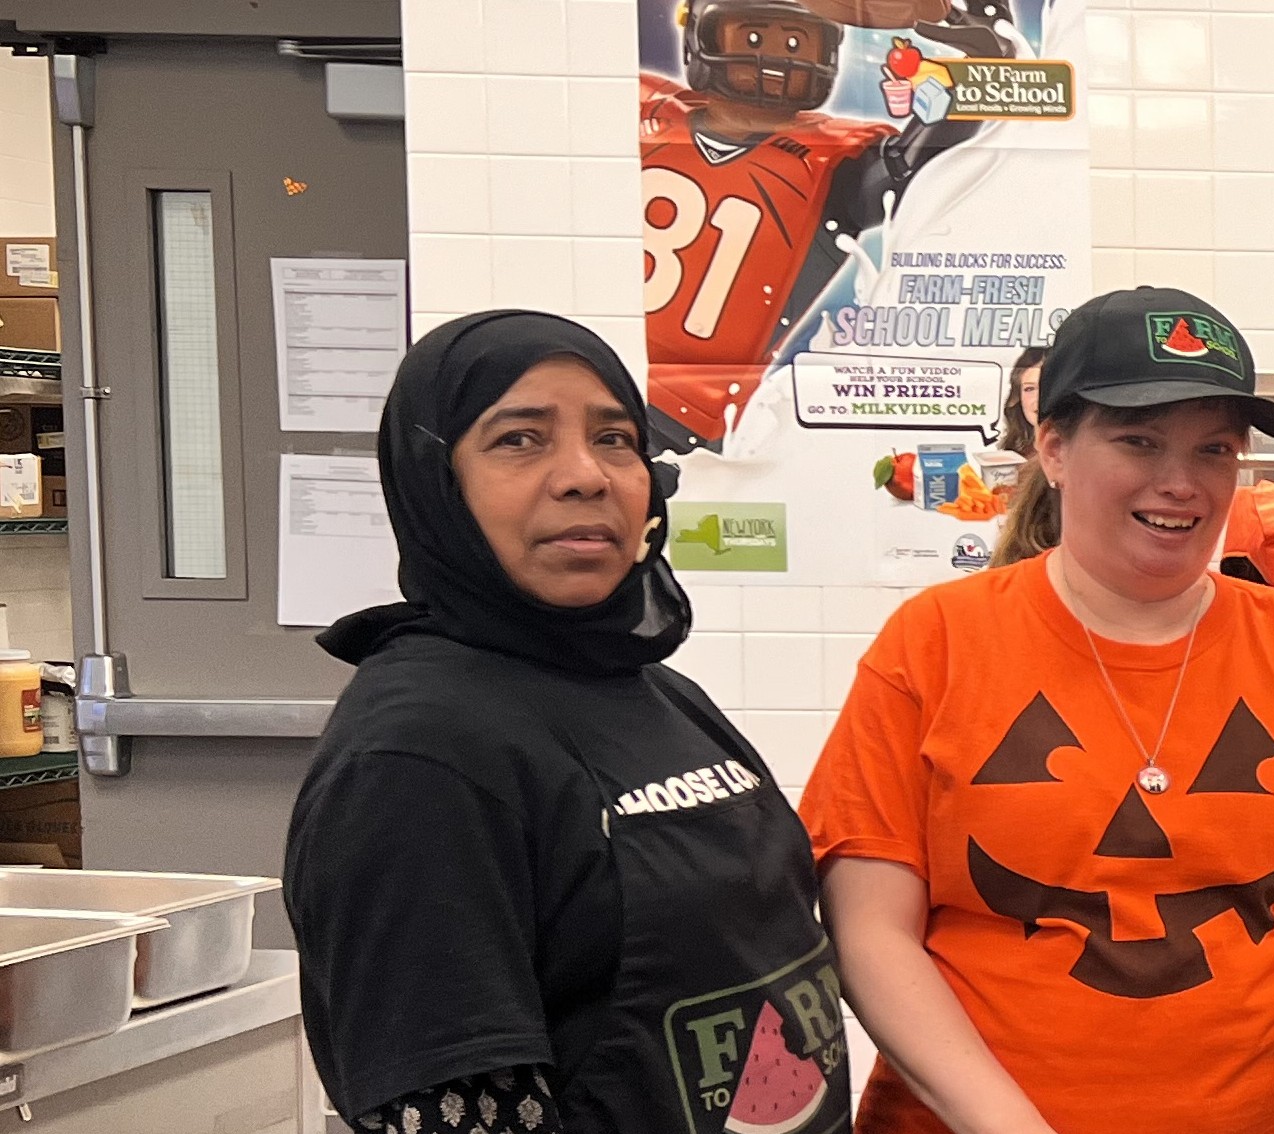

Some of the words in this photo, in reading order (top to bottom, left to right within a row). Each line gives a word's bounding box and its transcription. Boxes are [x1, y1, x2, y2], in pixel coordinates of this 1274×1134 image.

[968, 65, 995, 82] NY
[999, 65, 1047, 83] Farm
[956, 84, 982, 102] to
[986, 82, 1065, 103] School
[642, 165, 763, 340] 81
[891, 252, 943, 268] BUILDING
[945, 252, 989, 269] BLOCKS
[990, 253, 1012, 269] FOR
[898, 274, 1045, 306] FARM-FRESH
[833, 306, 956, 347] SCHOOL
[962, 307, 1072, 348] MEALS
[833, 366, 874, 376] WATCH
[877, 366, 887, 375] A
[891, 366, 916, 376] FUN
[921, 366, 962, 376] VIDEO!
[832, 384, 878, 398] WIN
[883, 385, 962, 399] PRIZES!
[807, 405, 826, 414] GO
[851, 402, 986, 416] MILKVIDS.COM
[929, 474, 946, 508] Milk
[612, 767, 730, 816] HOOSE
[700, 1086, 731, 1112] TO
